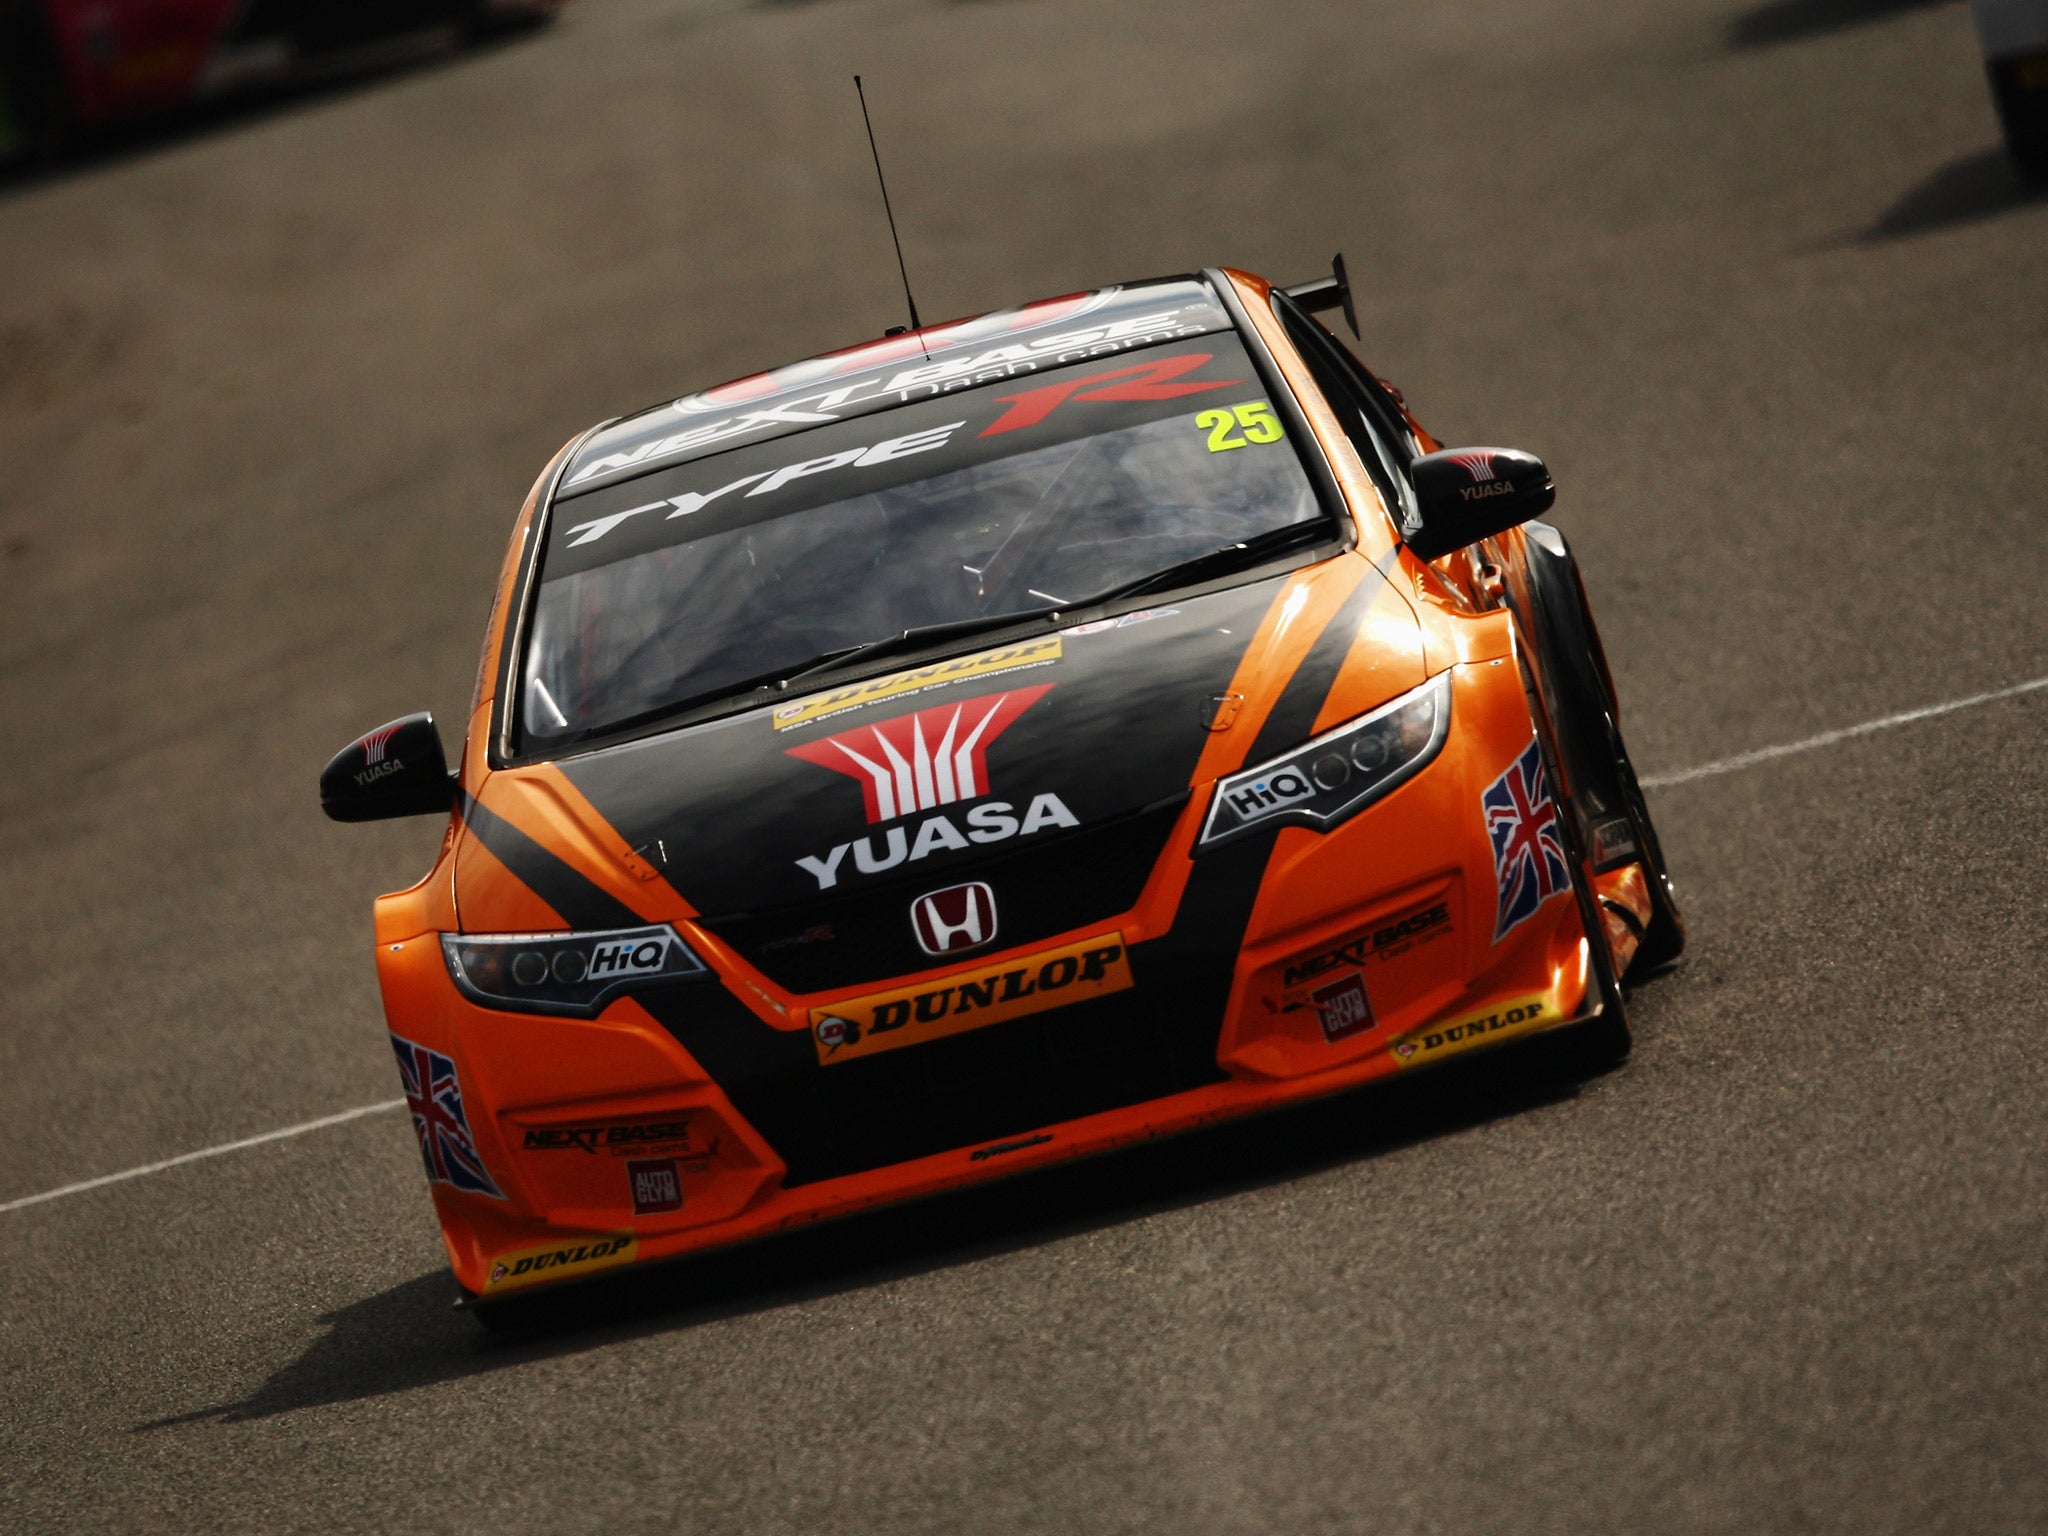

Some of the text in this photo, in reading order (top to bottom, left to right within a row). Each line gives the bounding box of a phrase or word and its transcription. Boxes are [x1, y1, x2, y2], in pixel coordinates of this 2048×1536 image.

[562, 310, 1181, 489] NEXT BASE
[1195, 402, 1285, 453] 25
[1460, 481, 1515, 500] YUASA
[821, 641, 1058, 707] DUNLOP
[353, 758, 405, 786] YUASA
[1229, 773, 1310, 816] HiQ
[795, 792, 1081, 890] YUASA
[593, 942, 663, 974] HiQ
[1283, 902, 1450, 986] NEXT BASE
[868, 944, 1122, 1035] DUNLOP
[1423, 1003, 1544, 1051] DUNLOP
[524, 1121, 689, 1154] NEXT BASE
[637, 1170, 675, 1188] AUTO
[510, 1237, 631, 1276] DUNLOP
